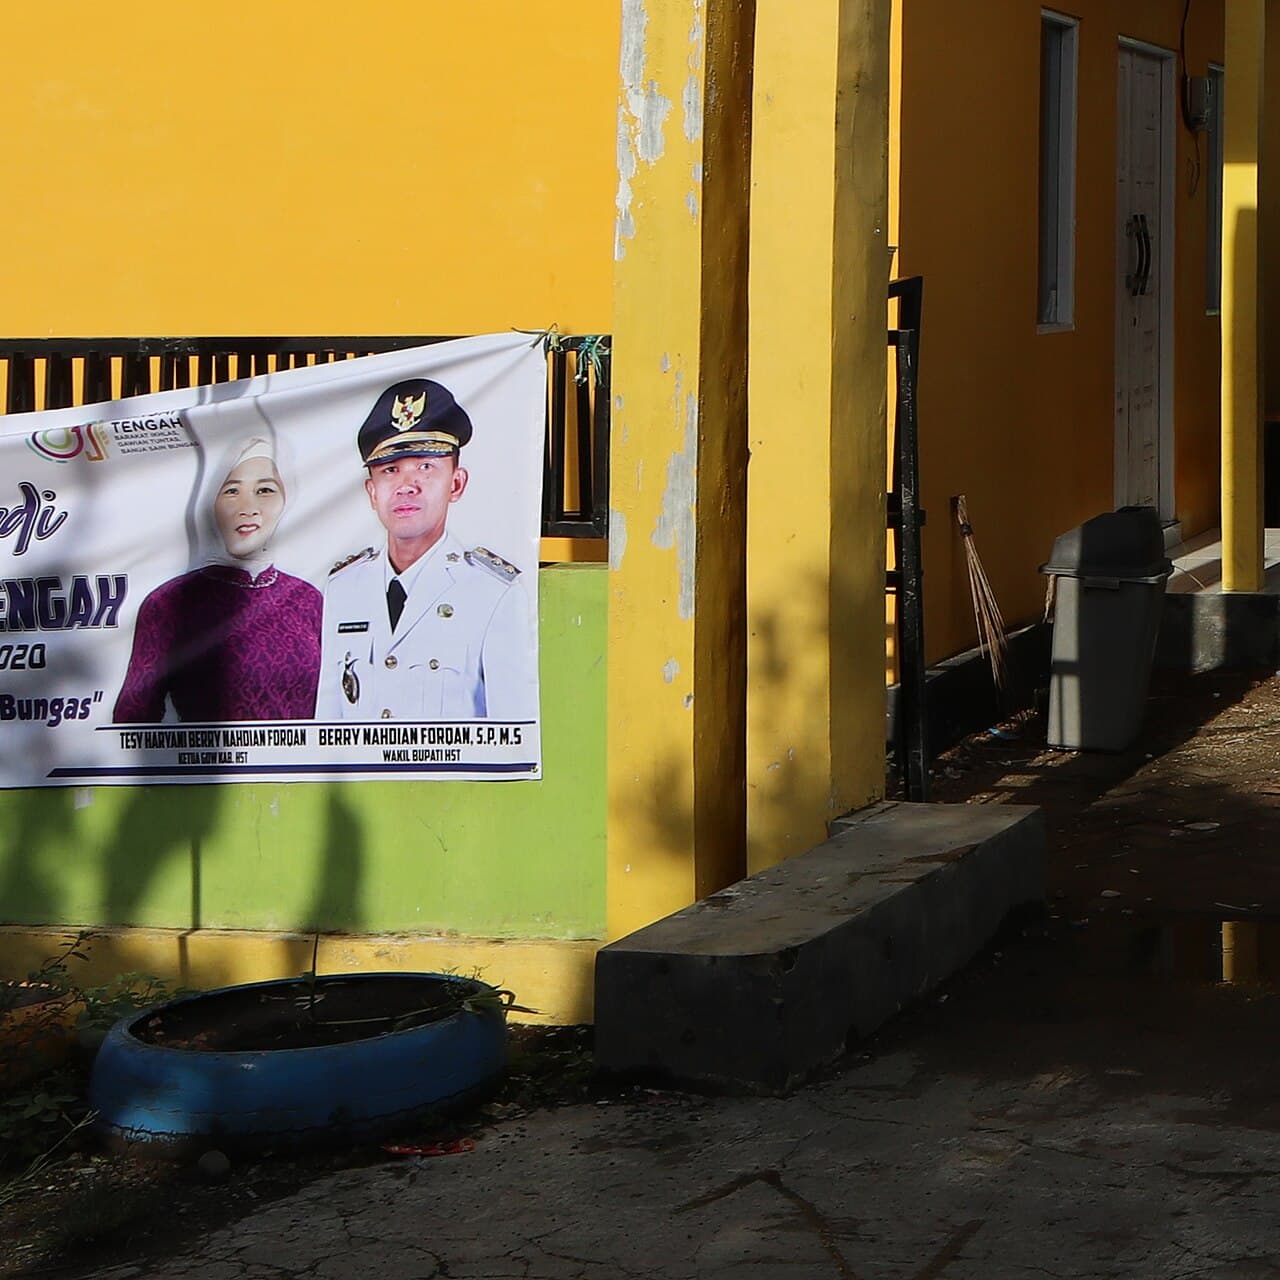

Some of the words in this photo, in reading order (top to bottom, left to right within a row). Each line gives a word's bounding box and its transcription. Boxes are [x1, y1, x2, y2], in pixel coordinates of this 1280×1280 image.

[111, 417, 184, 433] TENGAH
[119, 731, 143, 750] TESY
[188, 730, 222, 748] BERRY
[223, 729, 267, 747] NAHDIAN
[268, 728, 307, 747] FORQAN
[318, 727, 360, 746] BERRY
[363, 727, 418, 745] NAHDIAN
[421, 727, 474, 746] FORQAN,
[500, 727, 522, 745] M.S
[236, 751, 248, 764] HST
[382, 749, 411, 762] WAKIL
[412, 749, 443, 762] BUPATI
[444, 748, 461, 761] HST
